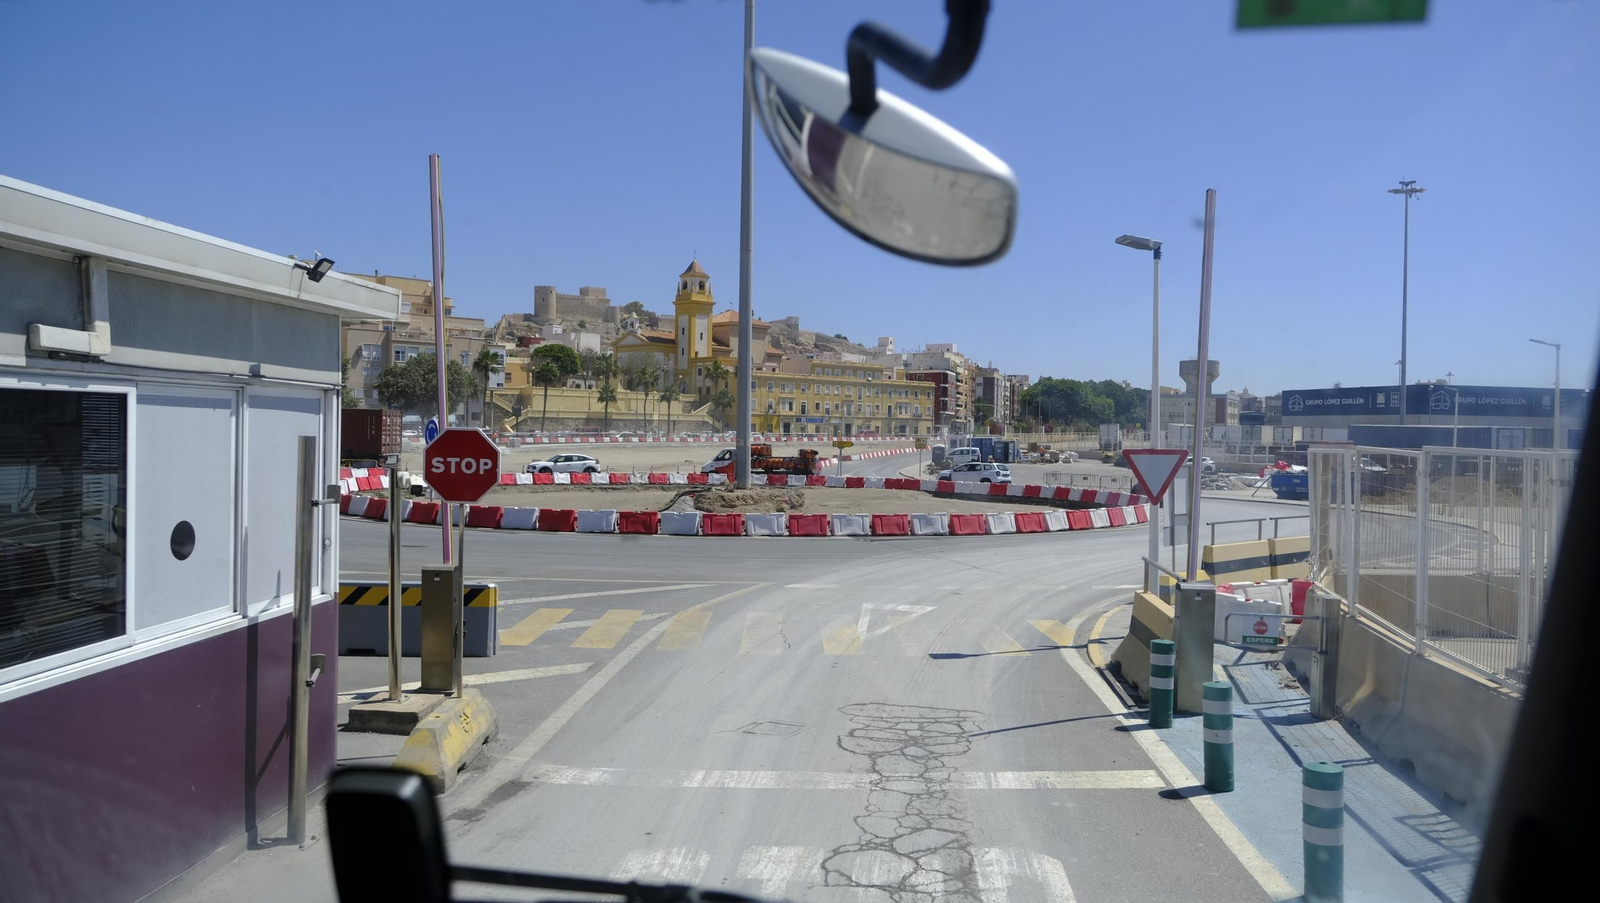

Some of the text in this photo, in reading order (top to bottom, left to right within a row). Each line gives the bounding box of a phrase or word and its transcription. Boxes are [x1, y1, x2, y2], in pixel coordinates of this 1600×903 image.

[1342, 396, 1364, 404] GUILLÉN
[1478, 396, 1498, 404] LÓPEZ
[431, 457, 493, 475] STOP
